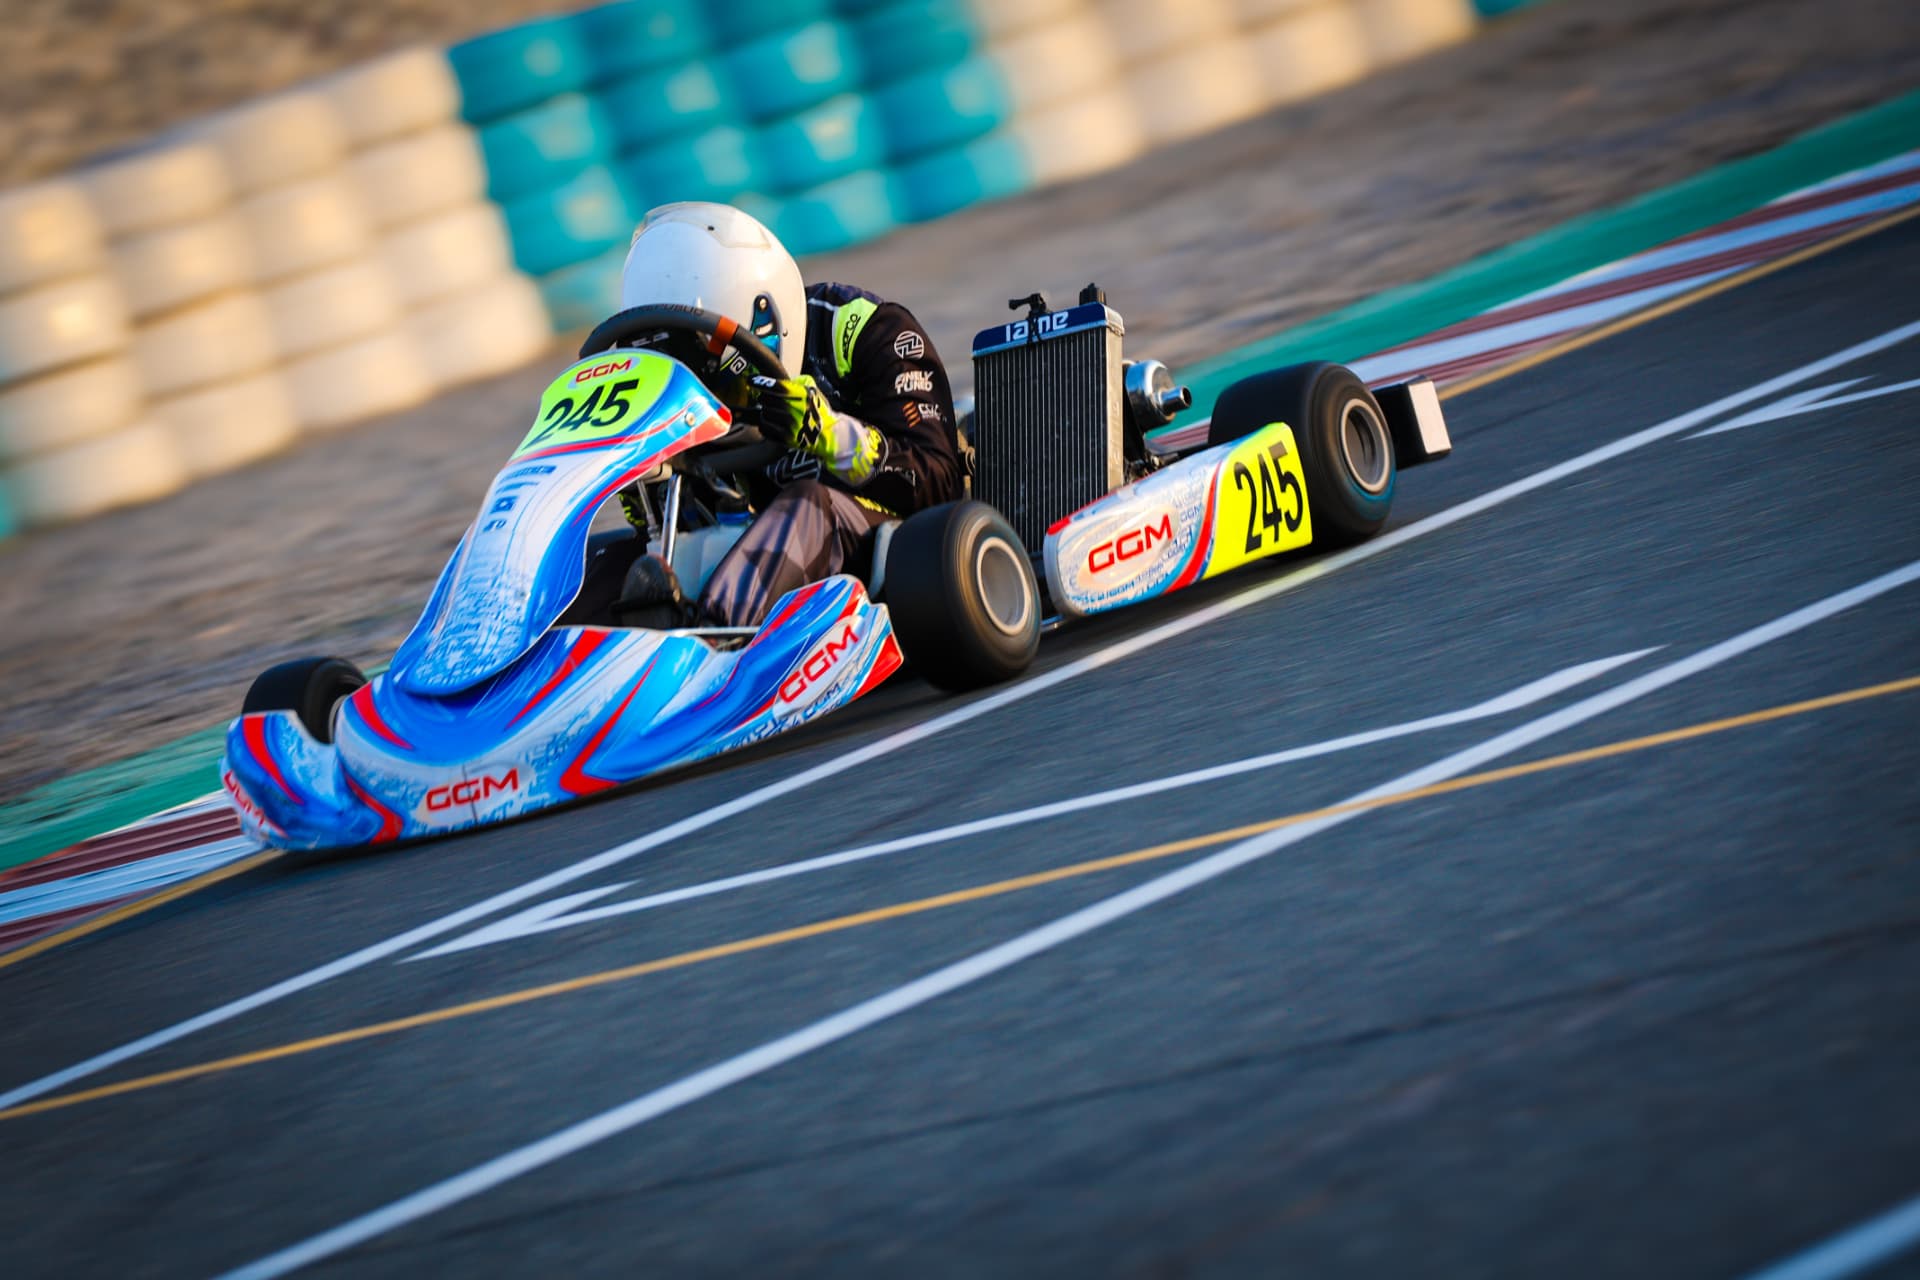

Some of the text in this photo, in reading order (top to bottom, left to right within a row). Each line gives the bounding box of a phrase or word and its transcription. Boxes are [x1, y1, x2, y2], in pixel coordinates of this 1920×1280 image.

[575, 358, 633, 384] GGM
[521, 378, 640, 451] 245
[1233, 440, 1304, 555] 245
[1088, 514, 1173, 574] GGM
[778, 624, 859, 704] GGM
[426, 767, 519, 812] GGM
